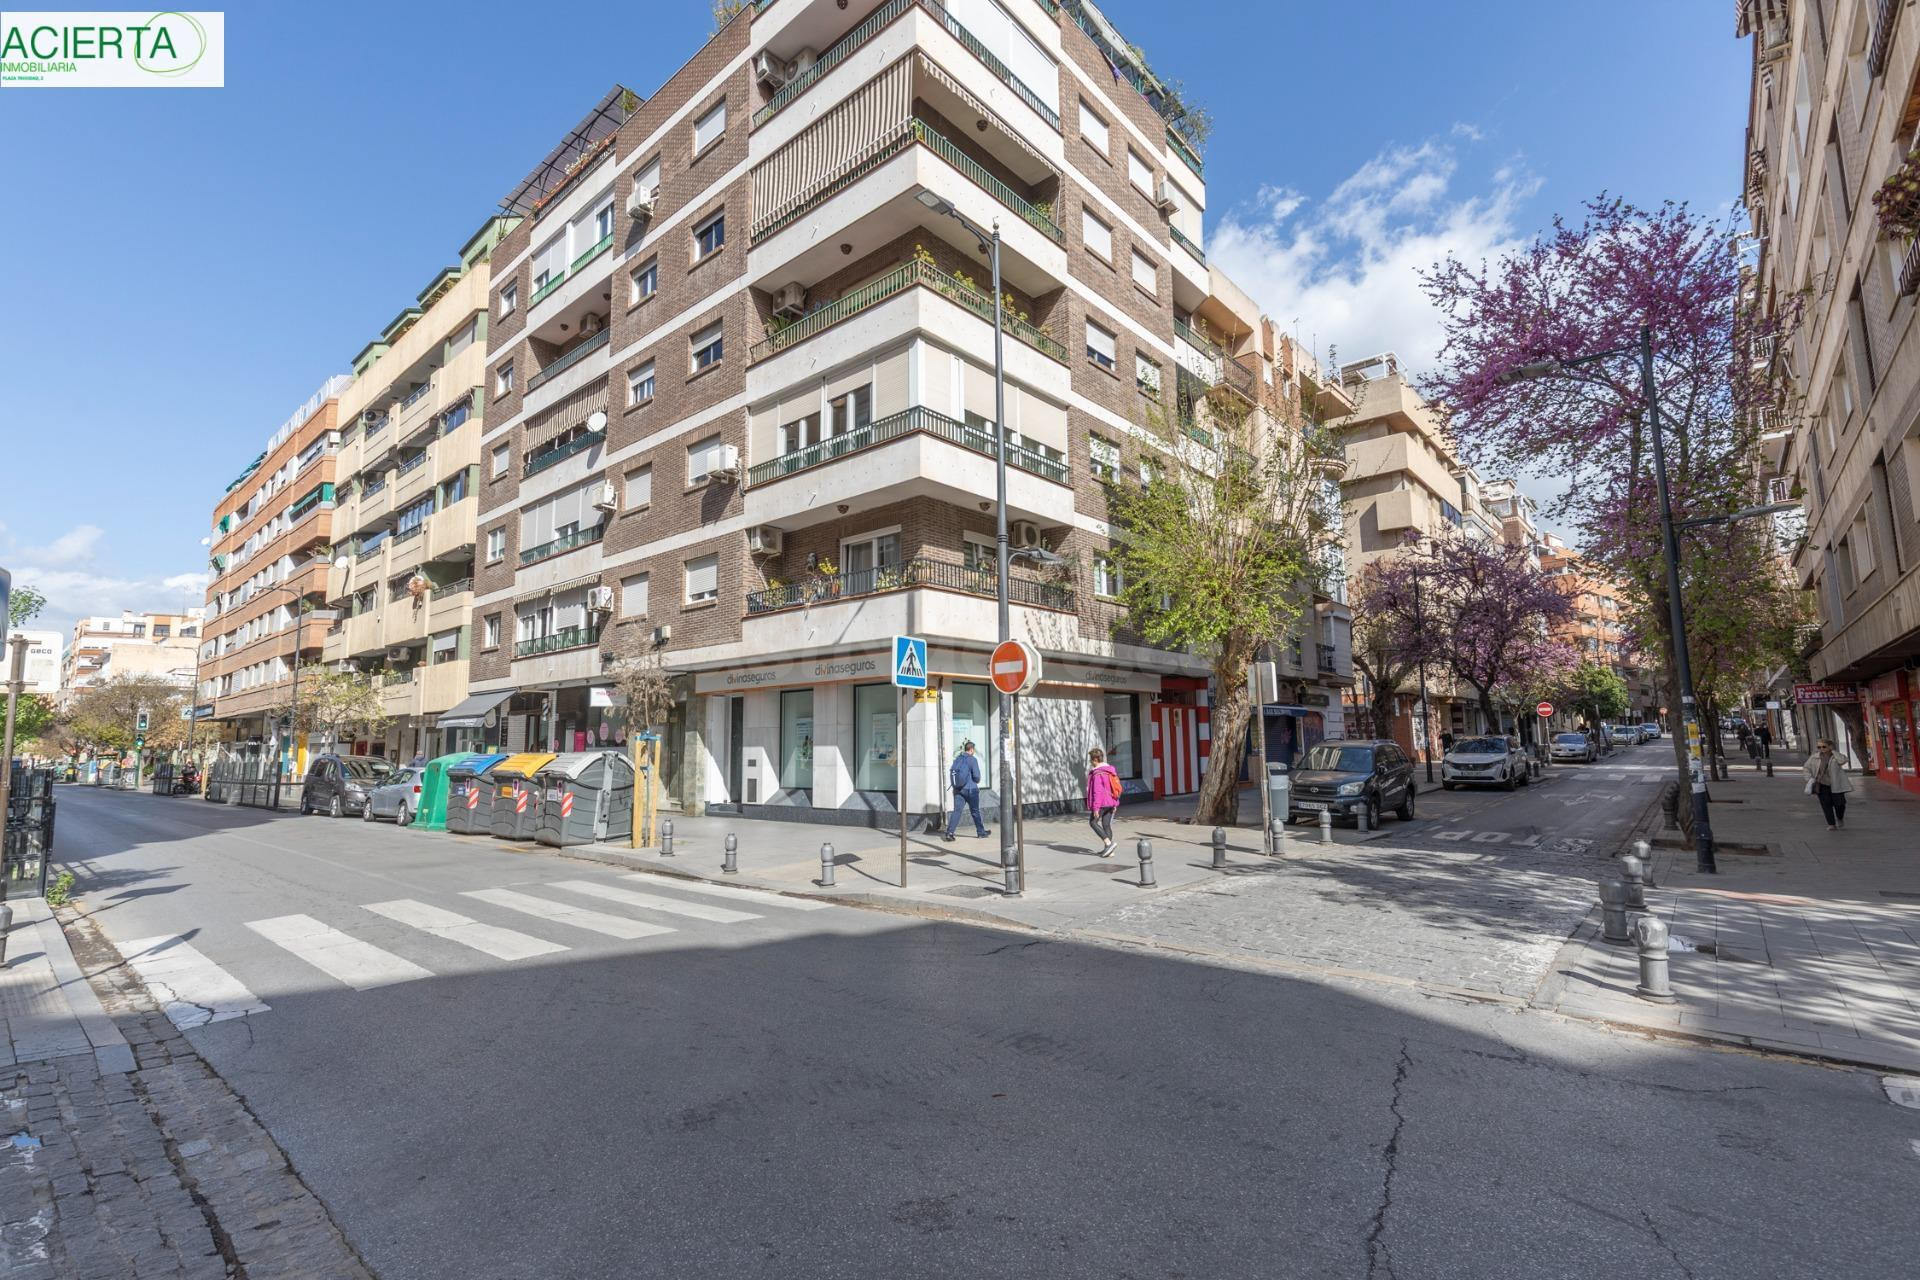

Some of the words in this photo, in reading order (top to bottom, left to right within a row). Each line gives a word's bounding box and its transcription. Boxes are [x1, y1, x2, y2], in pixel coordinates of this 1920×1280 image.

[815, 659, 875, 676] divinaseguros
[727, 670, 776, 685] divinaseguros
[1797, 687, 1845, 698] Francis
